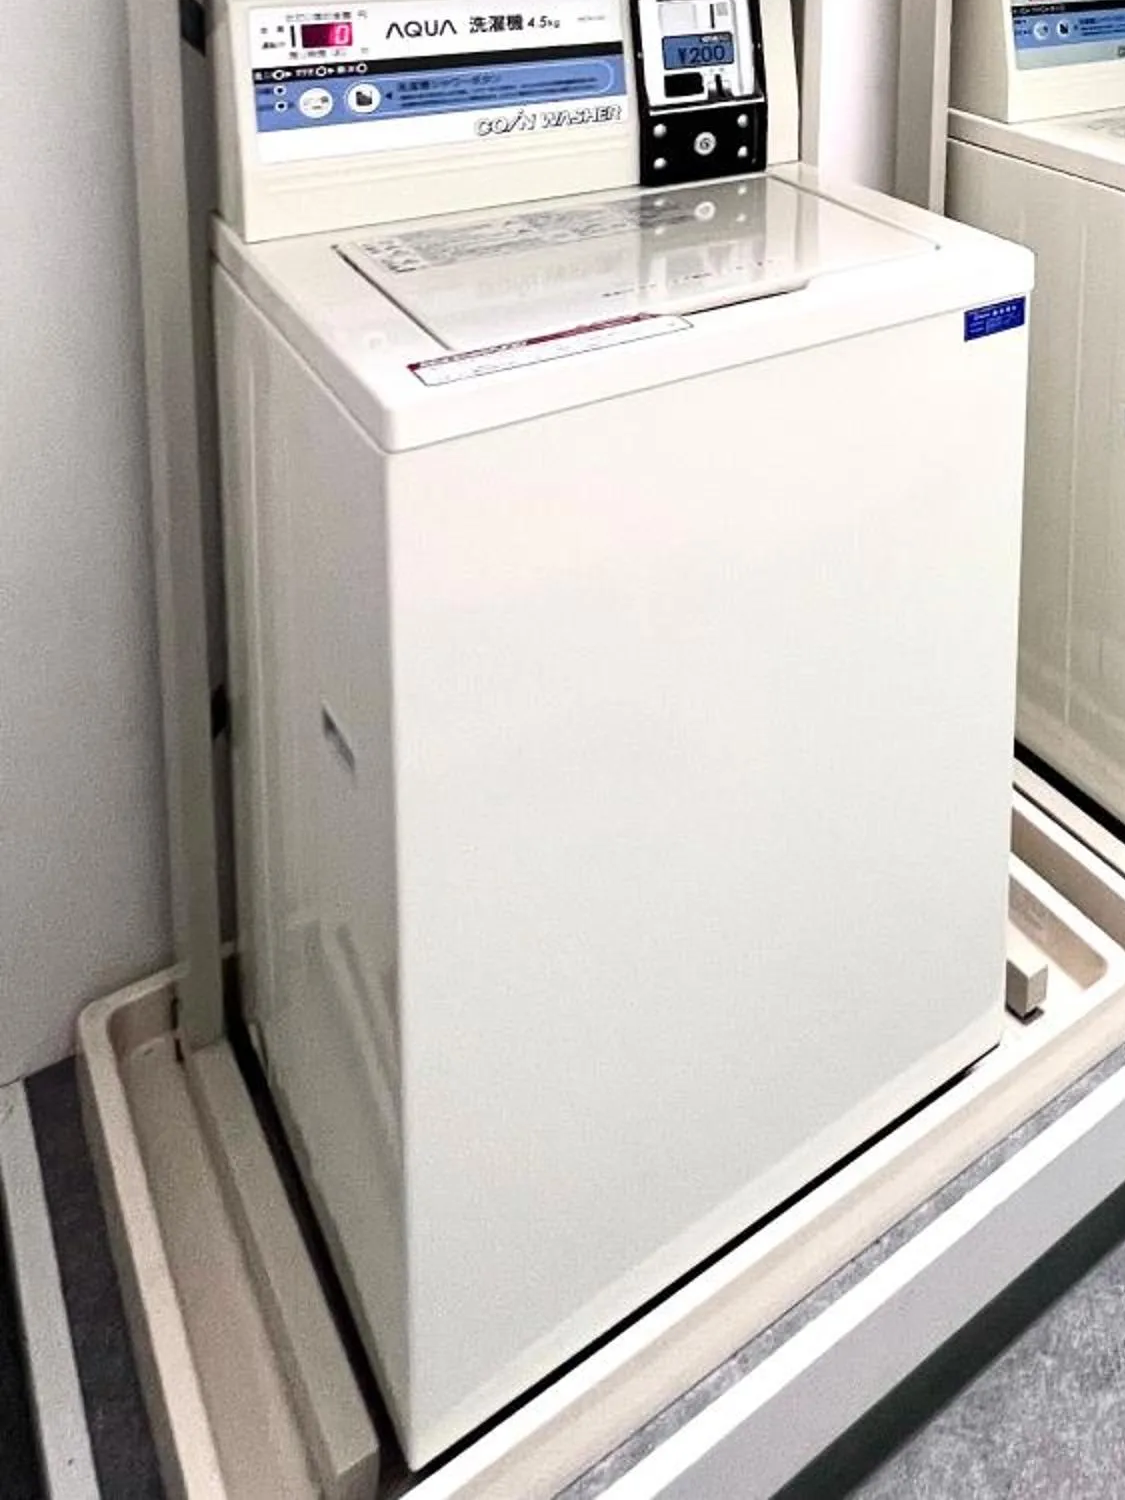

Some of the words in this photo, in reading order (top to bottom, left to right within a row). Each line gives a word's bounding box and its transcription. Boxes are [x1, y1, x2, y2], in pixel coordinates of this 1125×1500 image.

[385, 19, 458, 40] AQUA
[469, 13, 524, 34] 洗濯機
[335, 25, 350, 45] 0
[677, 45, 726, 65] ¥200
[540, 104, 622, 129] WASHER
